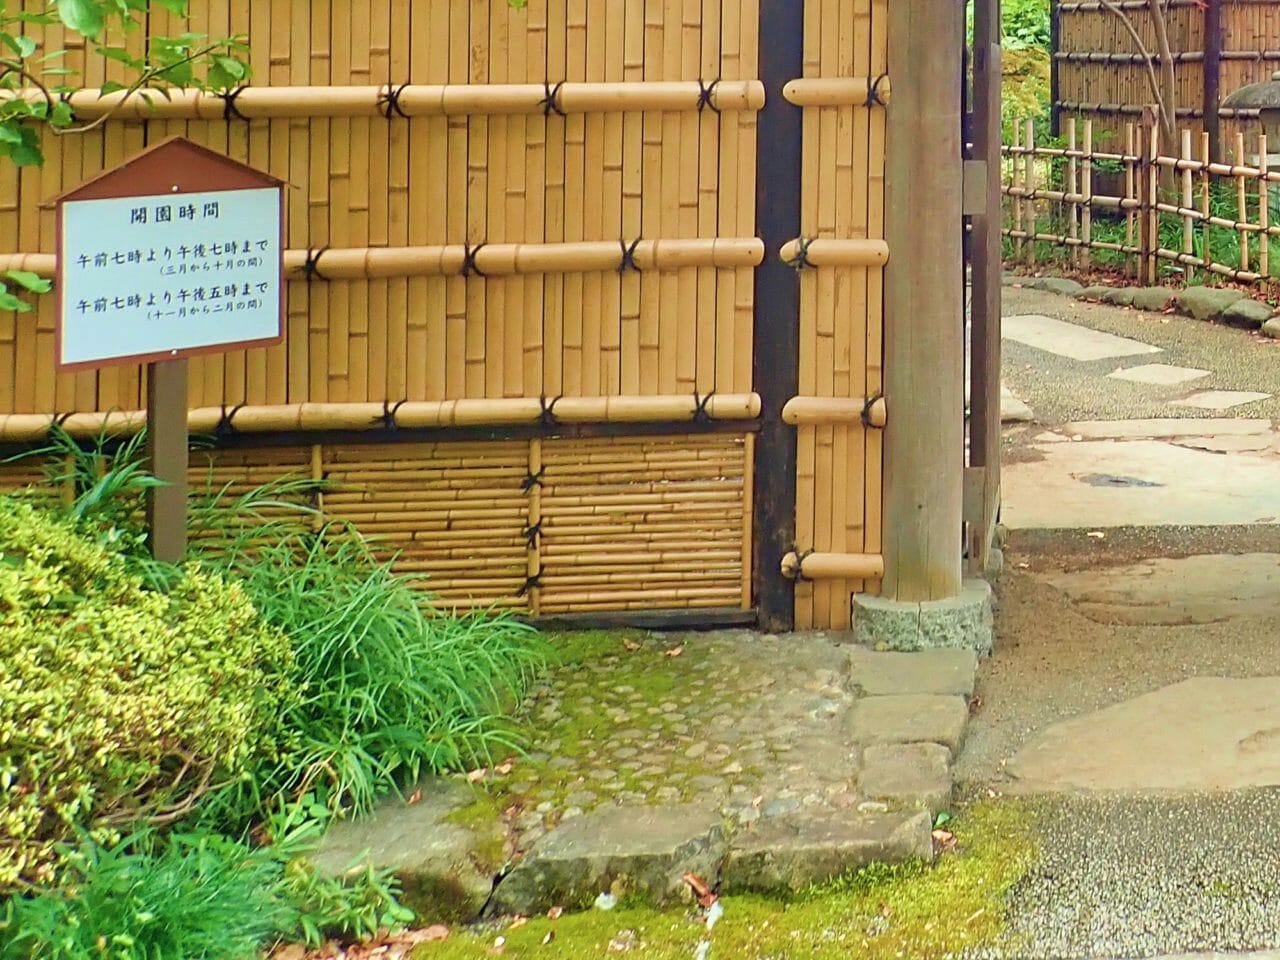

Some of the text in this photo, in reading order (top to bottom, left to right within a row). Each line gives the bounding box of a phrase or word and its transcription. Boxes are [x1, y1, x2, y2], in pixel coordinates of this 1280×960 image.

[130, 202, 219, 224] 開園時間
[76, 240, 268, 269] 午前七時より午後七時まで
[76, 282, 268, 313] 午前七時より午後五時まで
